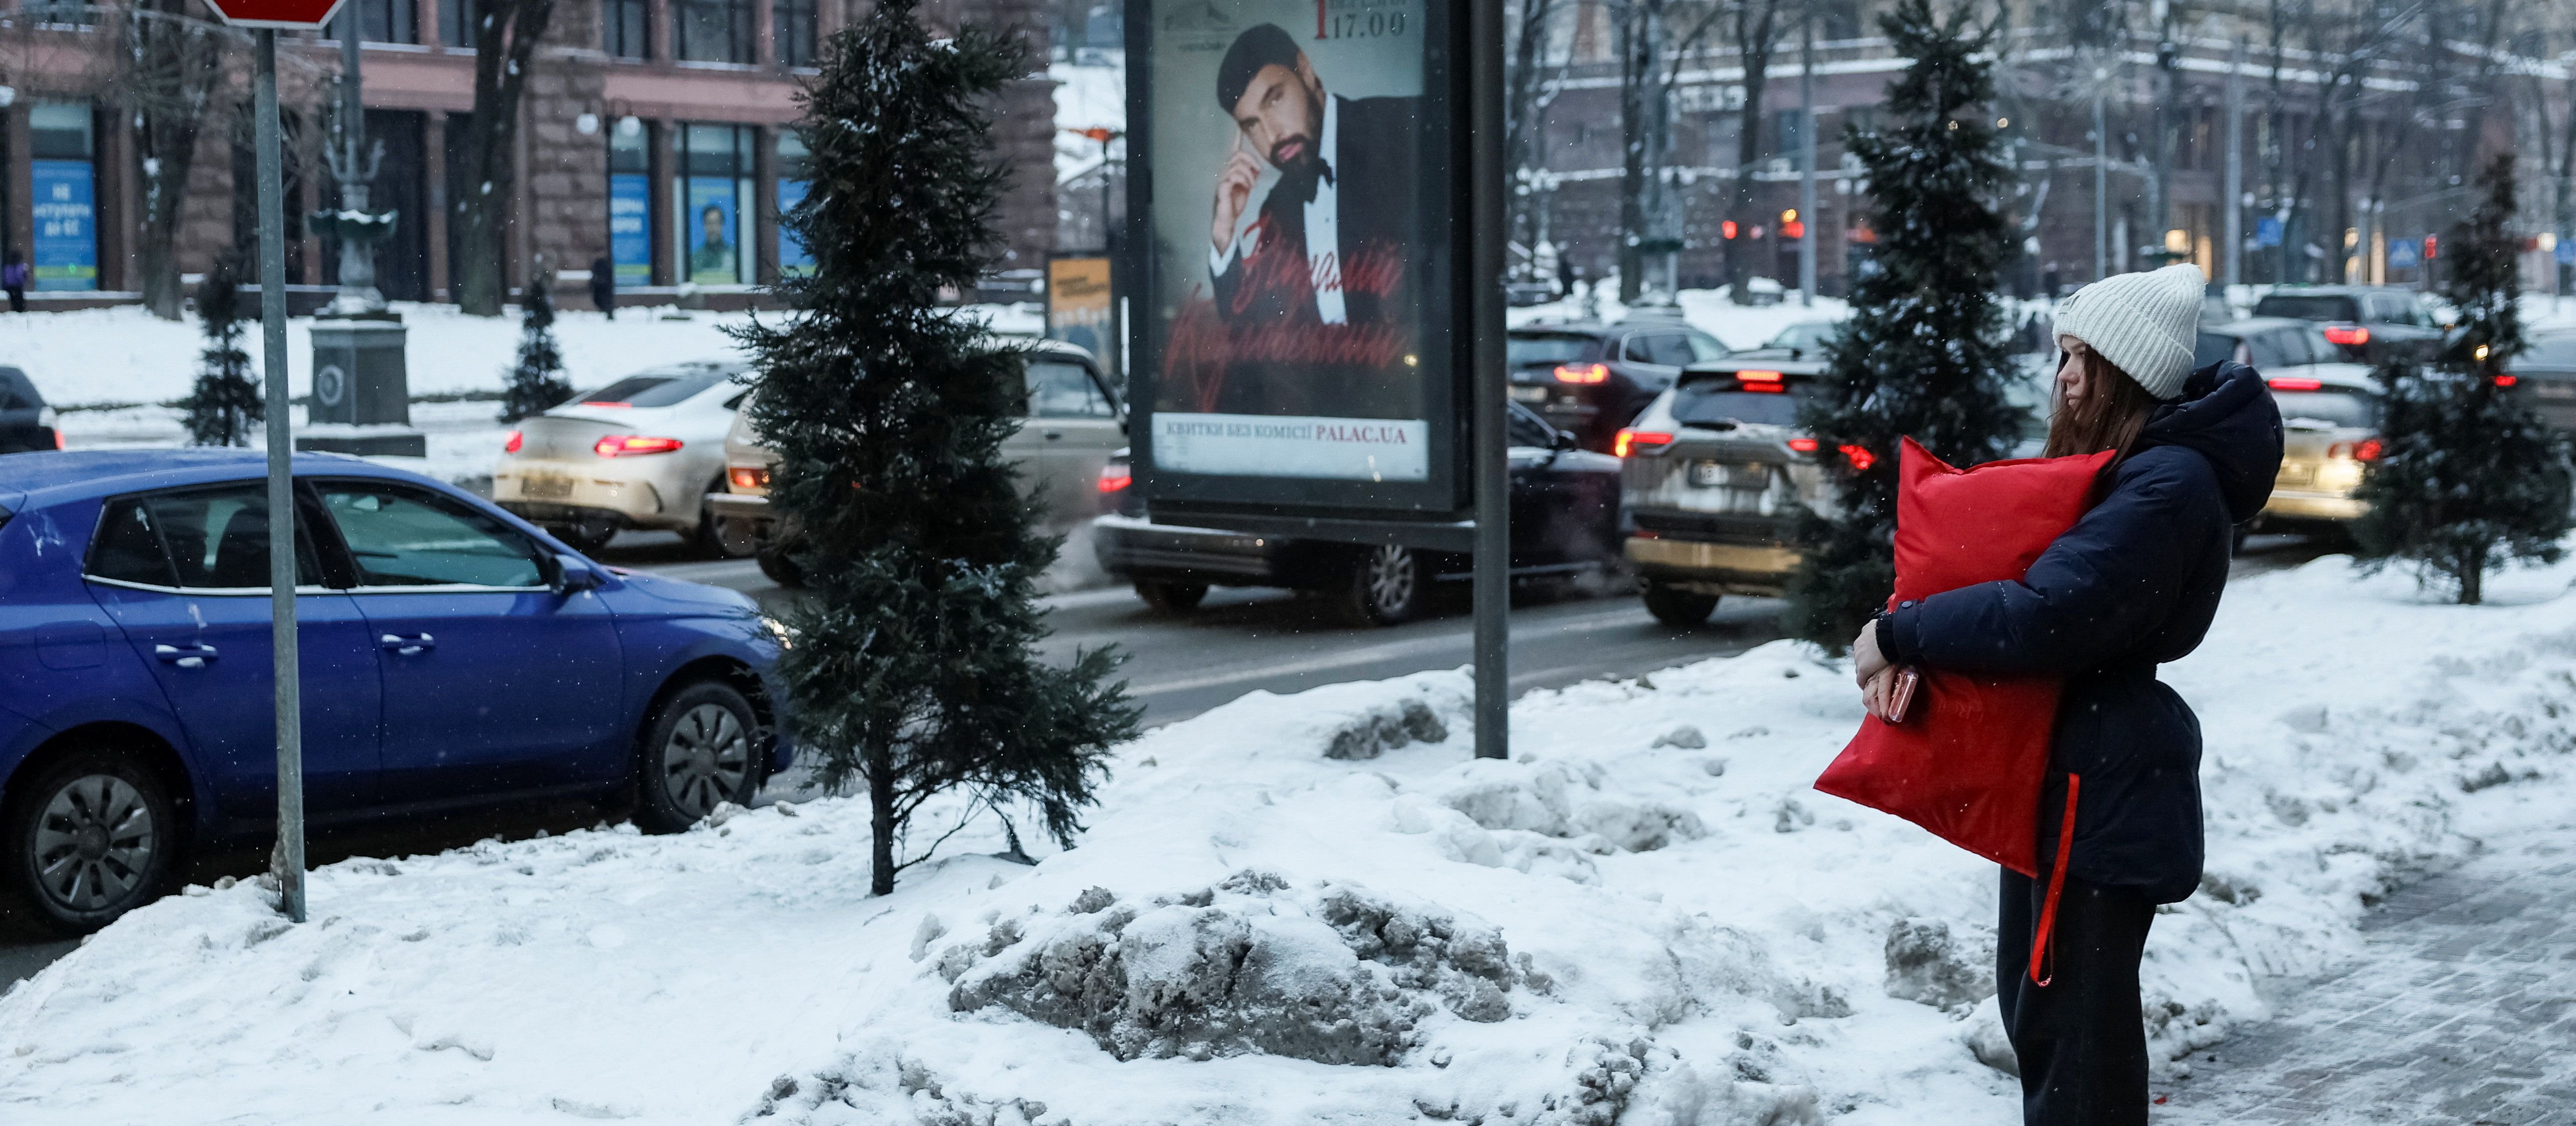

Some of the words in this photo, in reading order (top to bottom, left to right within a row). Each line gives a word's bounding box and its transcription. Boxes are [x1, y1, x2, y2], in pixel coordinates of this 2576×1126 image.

[1334, 11, 1405, 39] 17.00
[1166, 422, 1224, 436] КВИТКИ
[1227, 423, 1252, 438] БЕЗ
[1316, 425, 1407, 444] PALAC.UA
